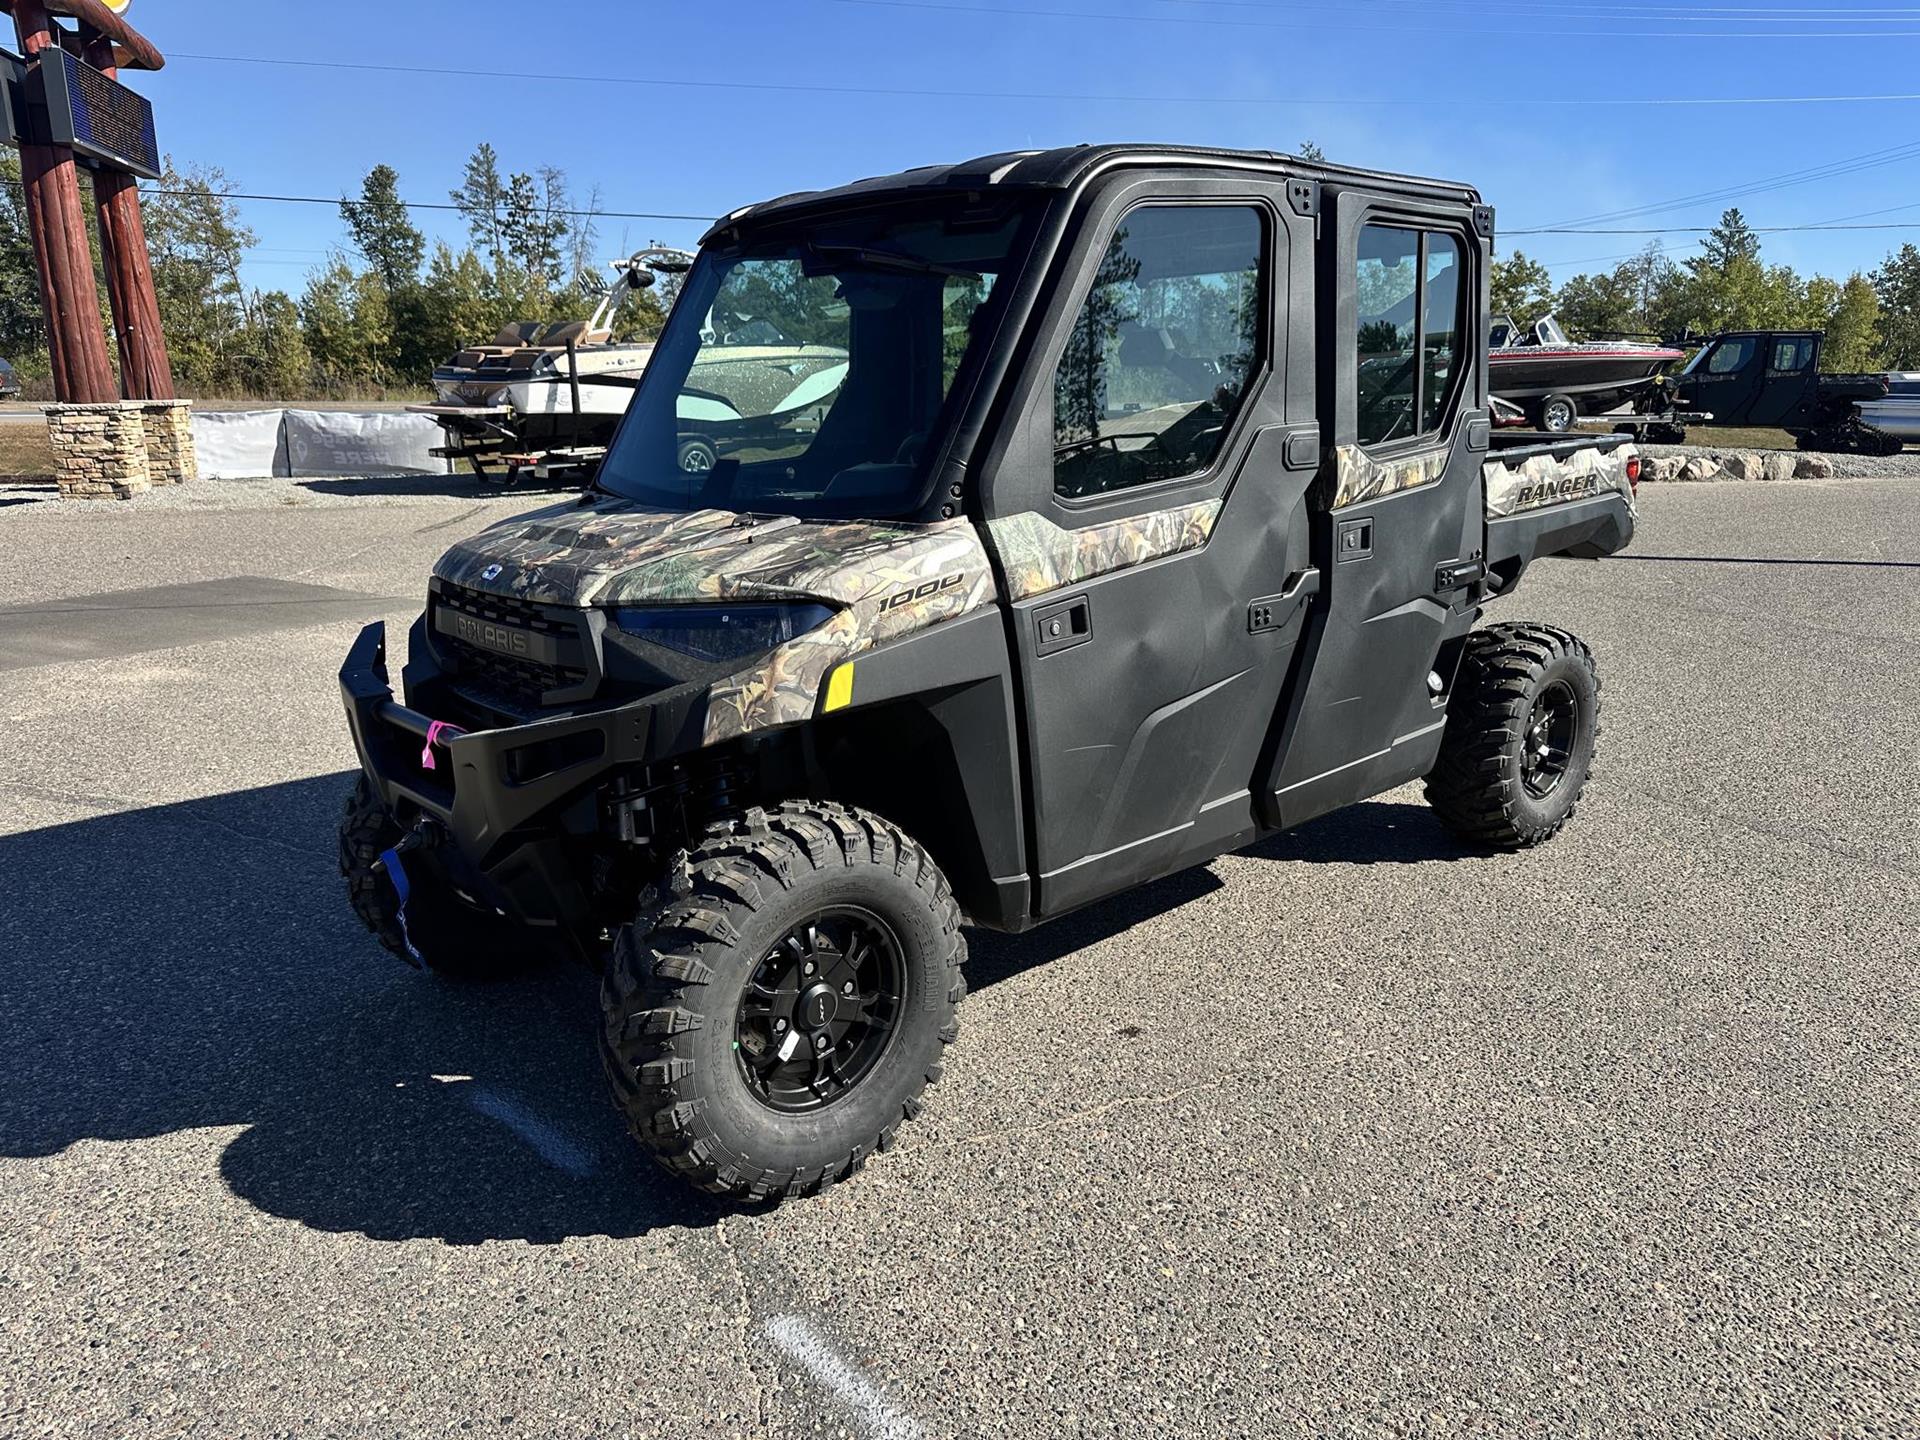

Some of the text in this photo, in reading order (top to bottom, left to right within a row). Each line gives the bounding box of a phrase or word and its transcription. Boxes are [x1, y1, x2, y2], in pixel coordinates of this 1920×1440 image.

[1516, 473, 1597, 503] RANGER
[879, 571, 965, 613] 1000
[458, 616, 526, 653] POLARIS
